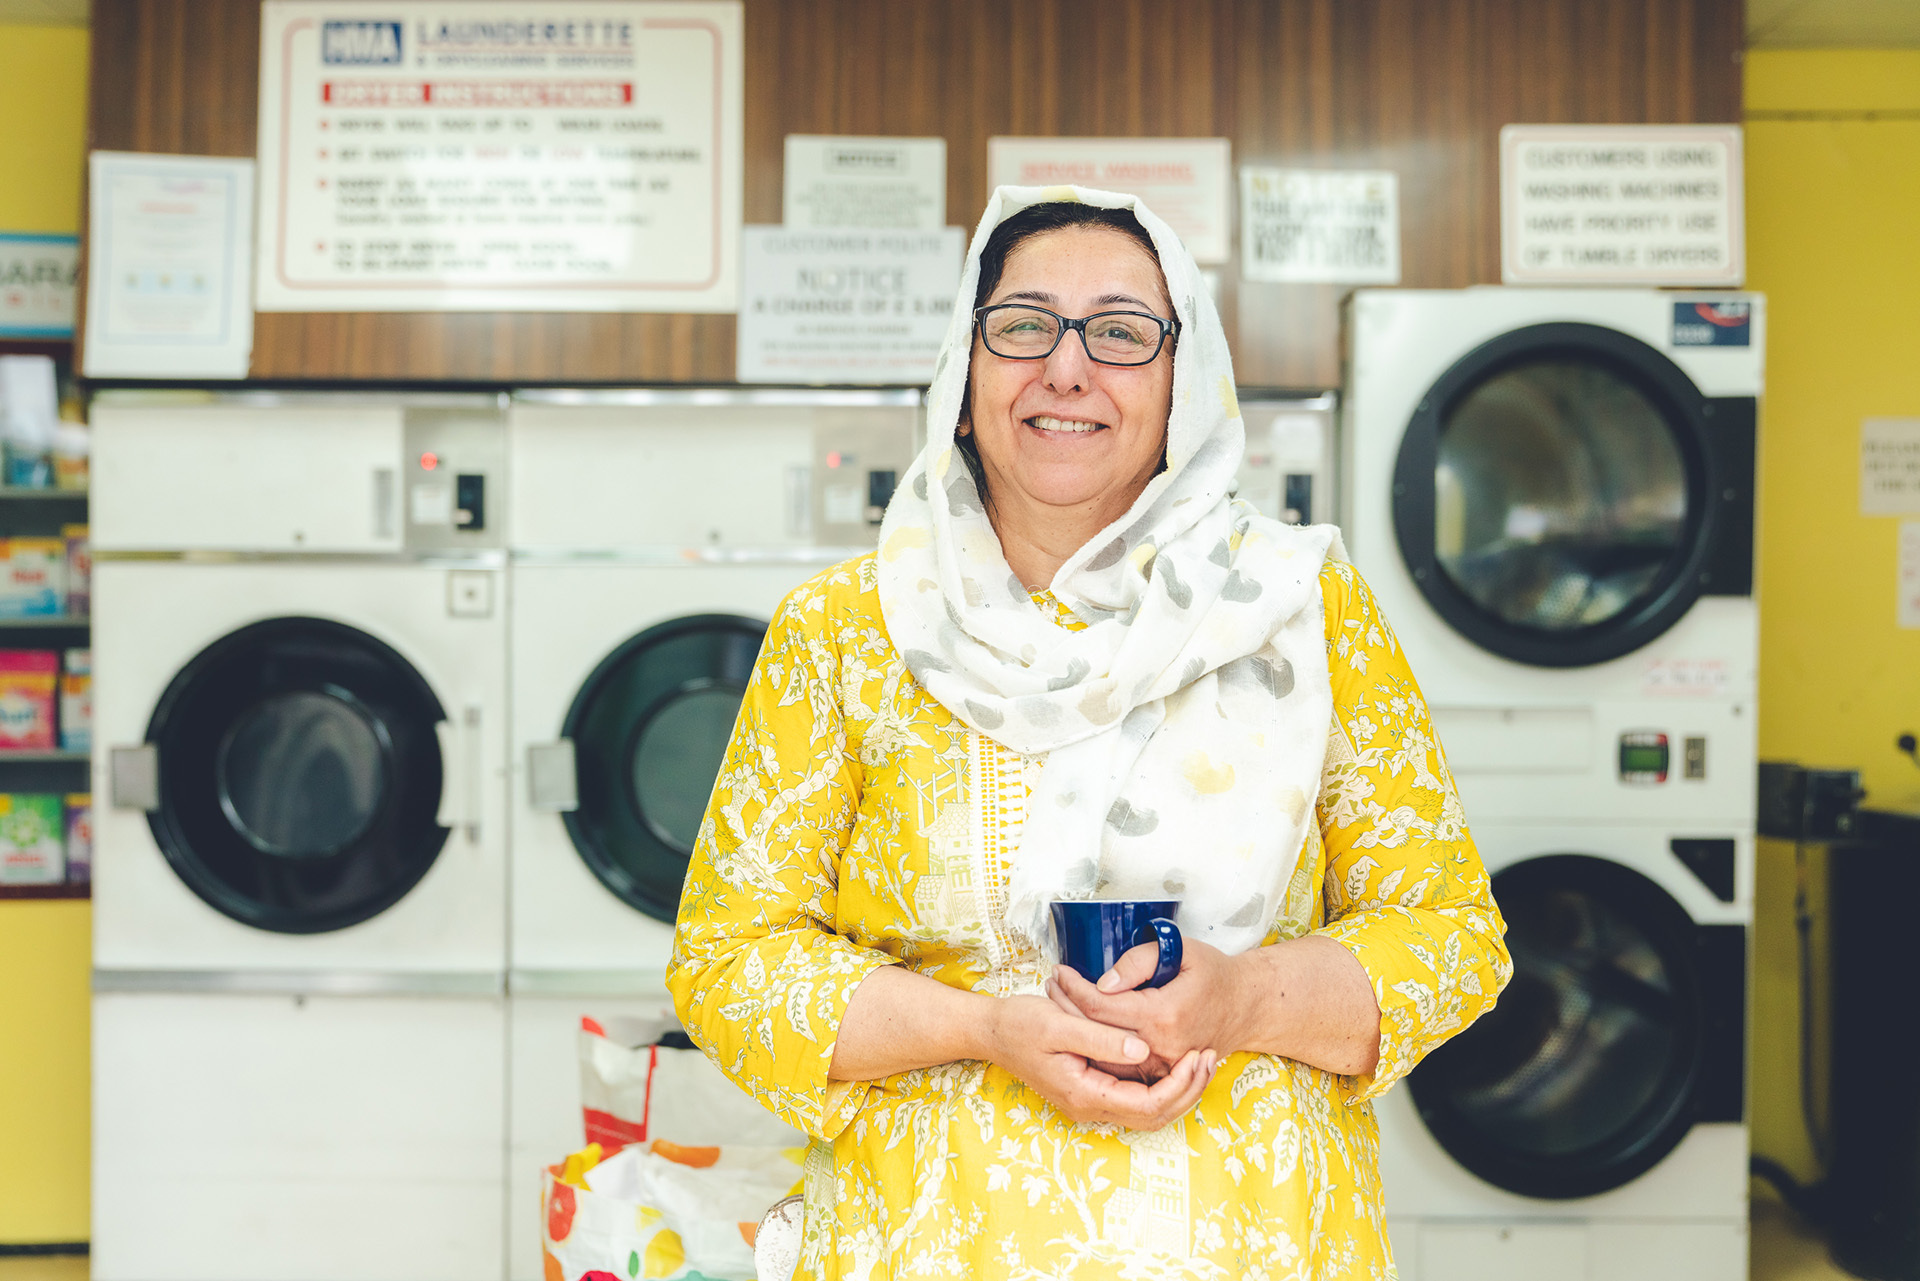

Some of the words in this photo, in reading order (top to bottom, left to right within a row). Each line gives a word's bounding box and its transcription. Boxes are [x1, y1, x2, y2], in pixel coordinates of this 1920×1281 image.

[417, 19, 633, 44] LAUNDERETTE
[335, 82, 420, 105] DRYER
[432, 82, 621, 105] INSTRUCTIONS
[834, 152, 898, 166] NOTICE
[1527, 148, 1648, 167] CUSTOMERS
[1656, 148, 1717, 167] USING
[1021, 160, 1095, 177] SERVICE
[1103, 161, 1194, 177] WASHING
[1525, 180, 1613, 199] WASHING
[1621, 180, 1720, 199] MACHINES
[1527, 214, 1577, 232] HAVE
[1583, 214, 1672, 232] PRIORITY
[1681, 214, 1718, 232] USE
[764, 235, 873, 254] CUSTOMER
[877, 235, 944, 254] POLITE
[1526, 247, 1553, 265] OF
[1564, 247, 1640, 265] TUMBLE
[1646, 247, 1722, 265] DRYERS
[796, 268, 908, 294] NOTICE
[753, 298, 767, 314] A
[773, 298, 855, 314] CHARGE
[861, 298, 888, 314] OF
